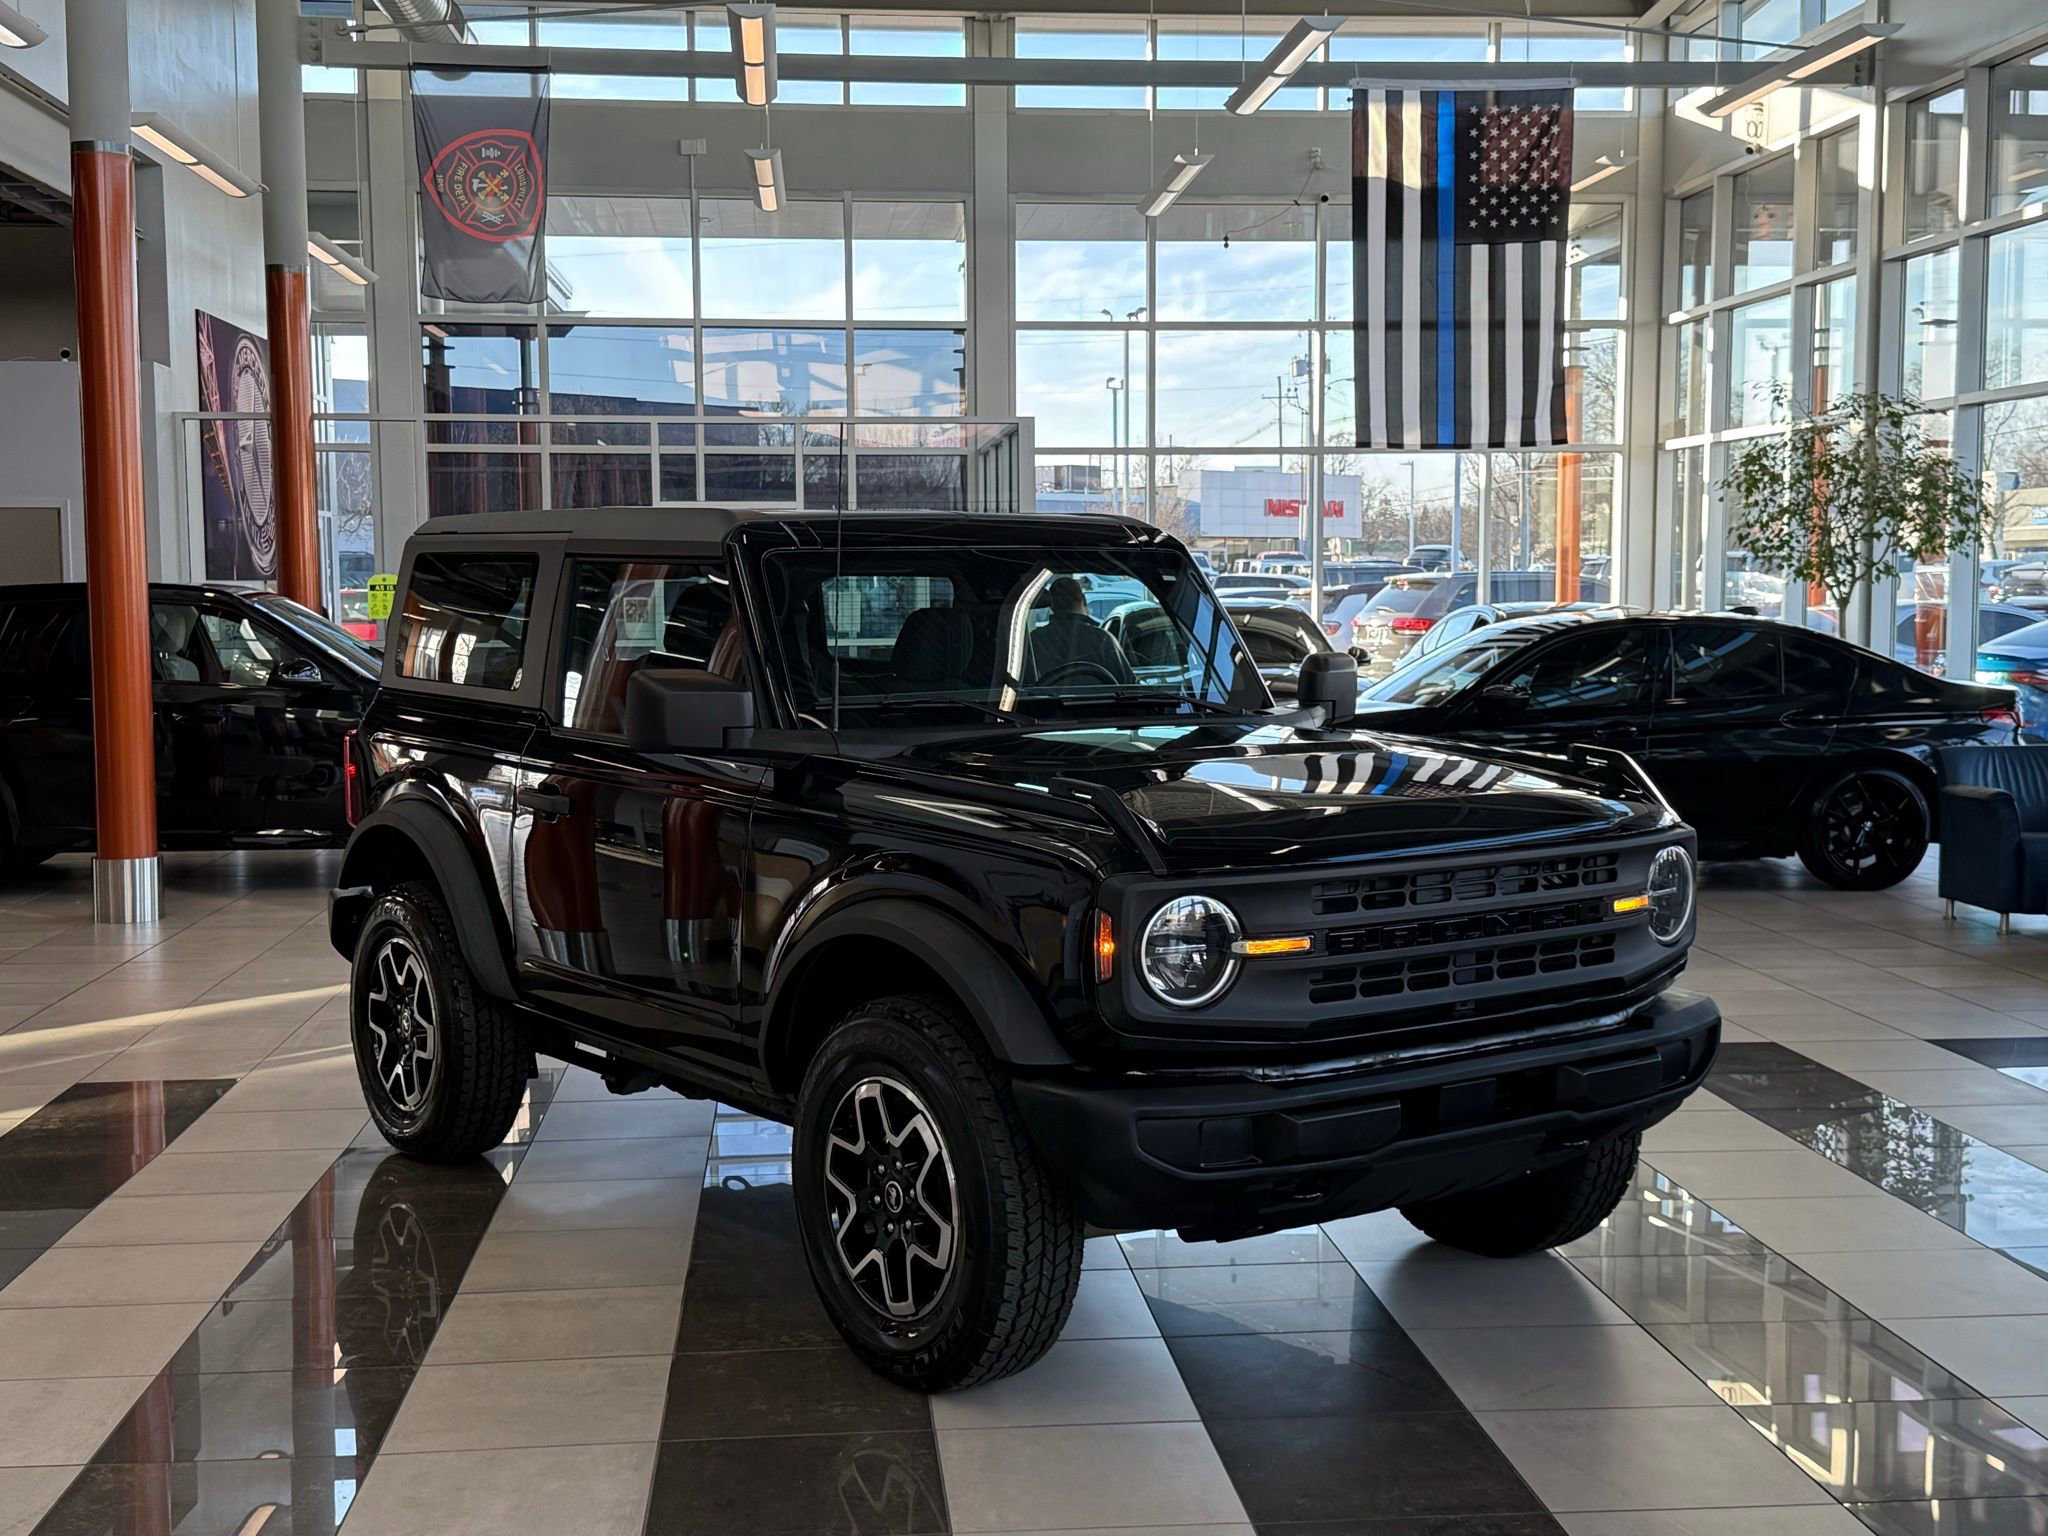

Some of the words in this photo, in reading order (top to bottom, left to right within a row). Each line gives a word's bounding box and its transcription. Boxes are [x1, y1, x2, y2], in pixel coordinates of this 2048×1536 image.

[454, 161, 468, 182] FIRE
[454, 183, 469, 208] DEPT.
[514, 163, 527, 208] LOUISVILLE
[1265, 498, 1344, 517] NISN
